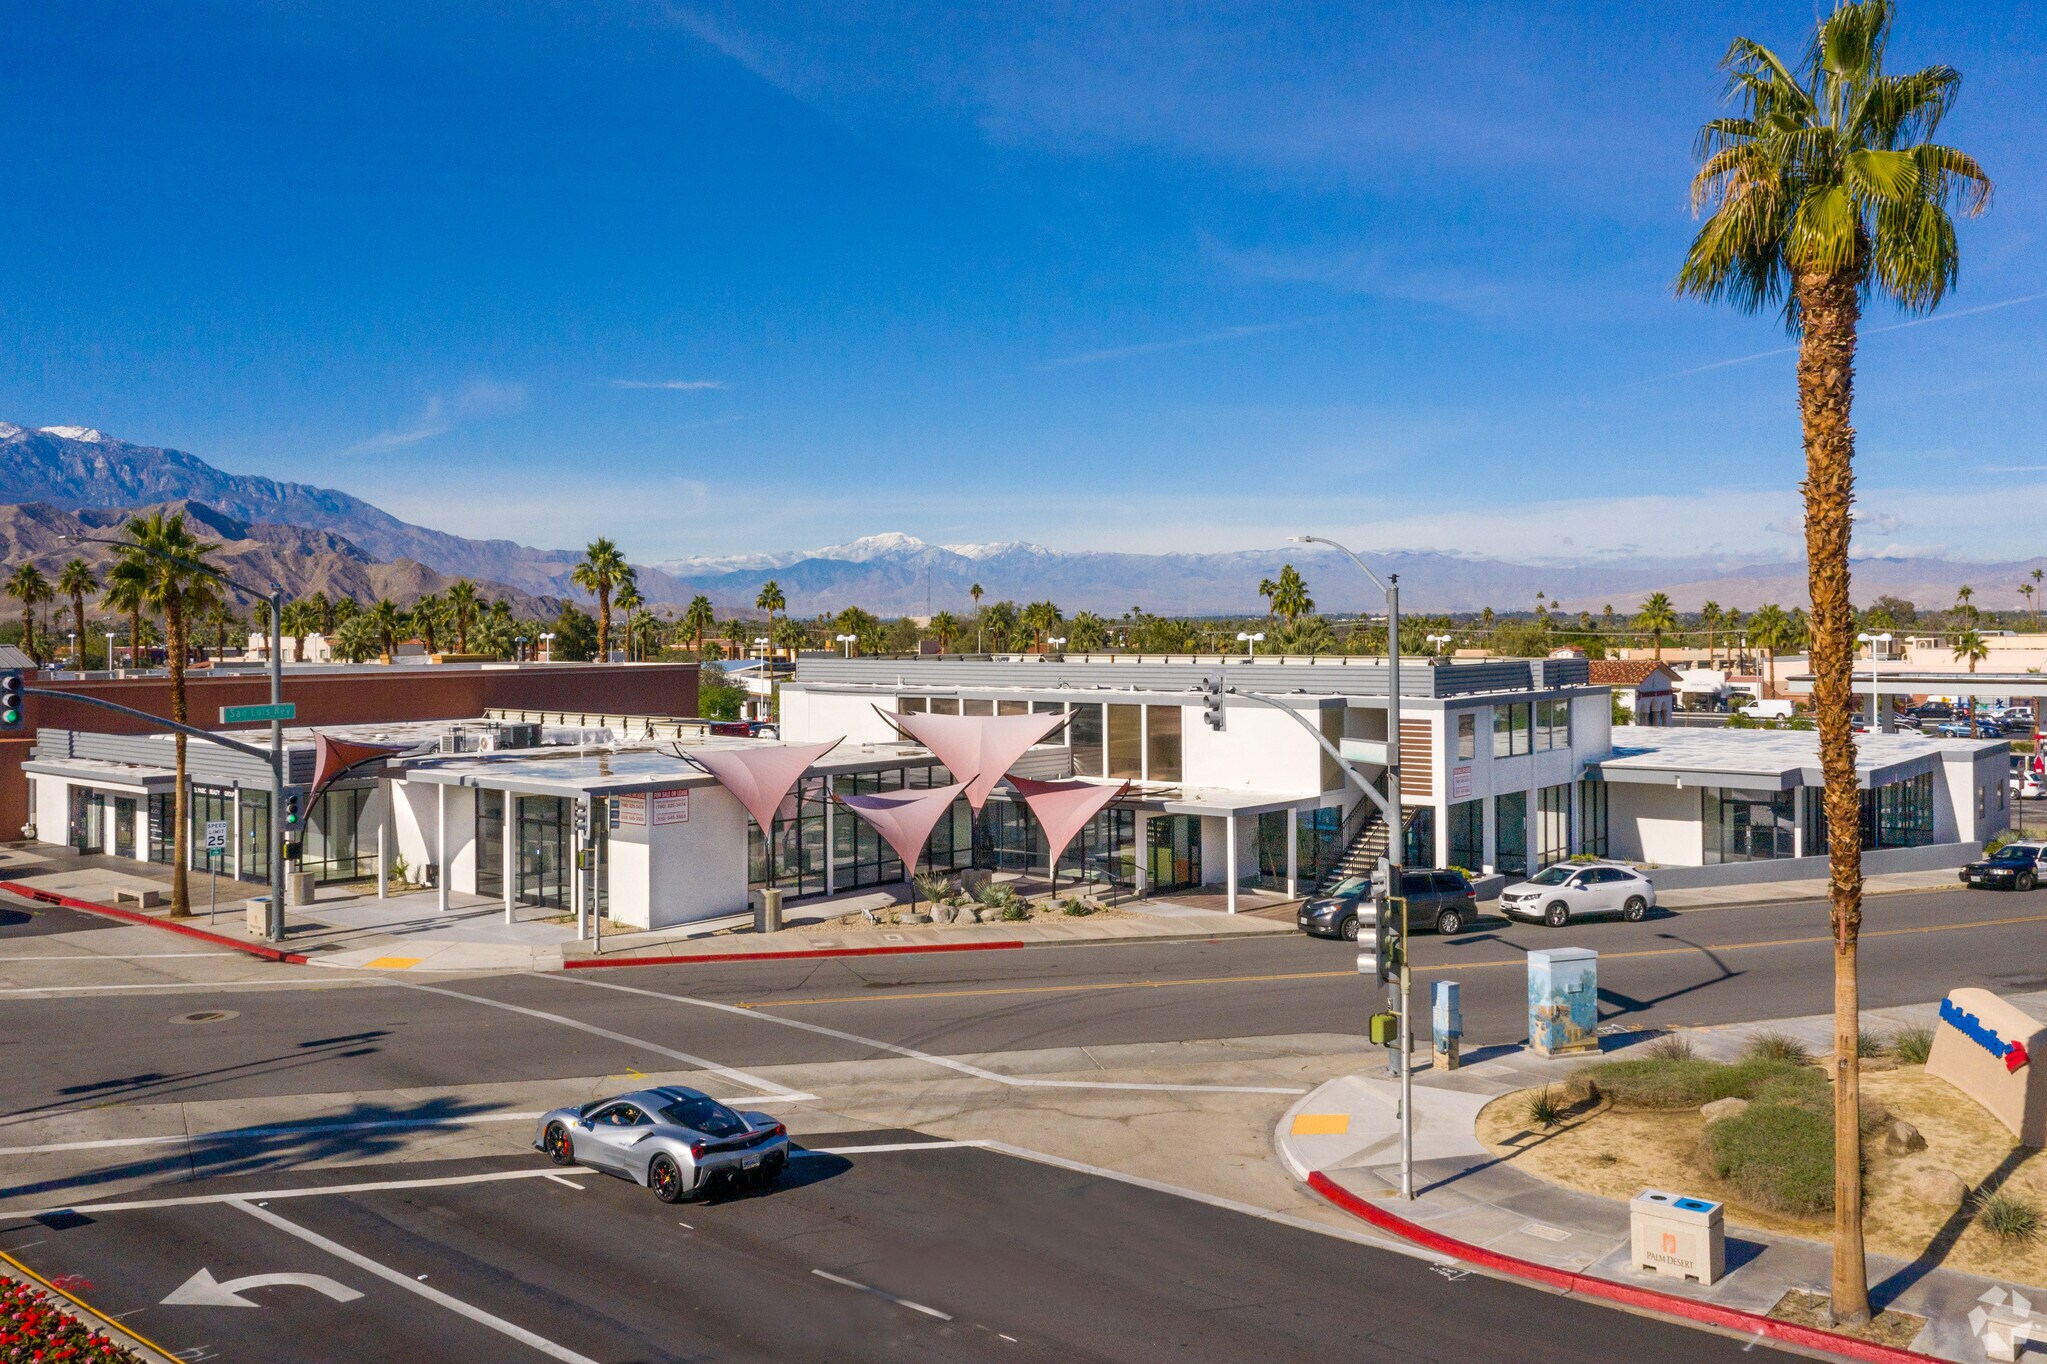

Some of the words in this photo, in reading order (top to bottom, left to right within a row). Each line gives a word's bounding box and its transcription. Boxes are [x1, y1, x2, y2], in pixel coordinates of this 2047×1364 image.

[229, 708, 247, 718] San
[251, 707, 271, 717] Luis
[274, 706, 290, 716] Rey
[208, 835, 225, 846] 25
[1646, 1251, 1666, 1263] PALM
[1667, 1255, 1694, 1269] DESERT
